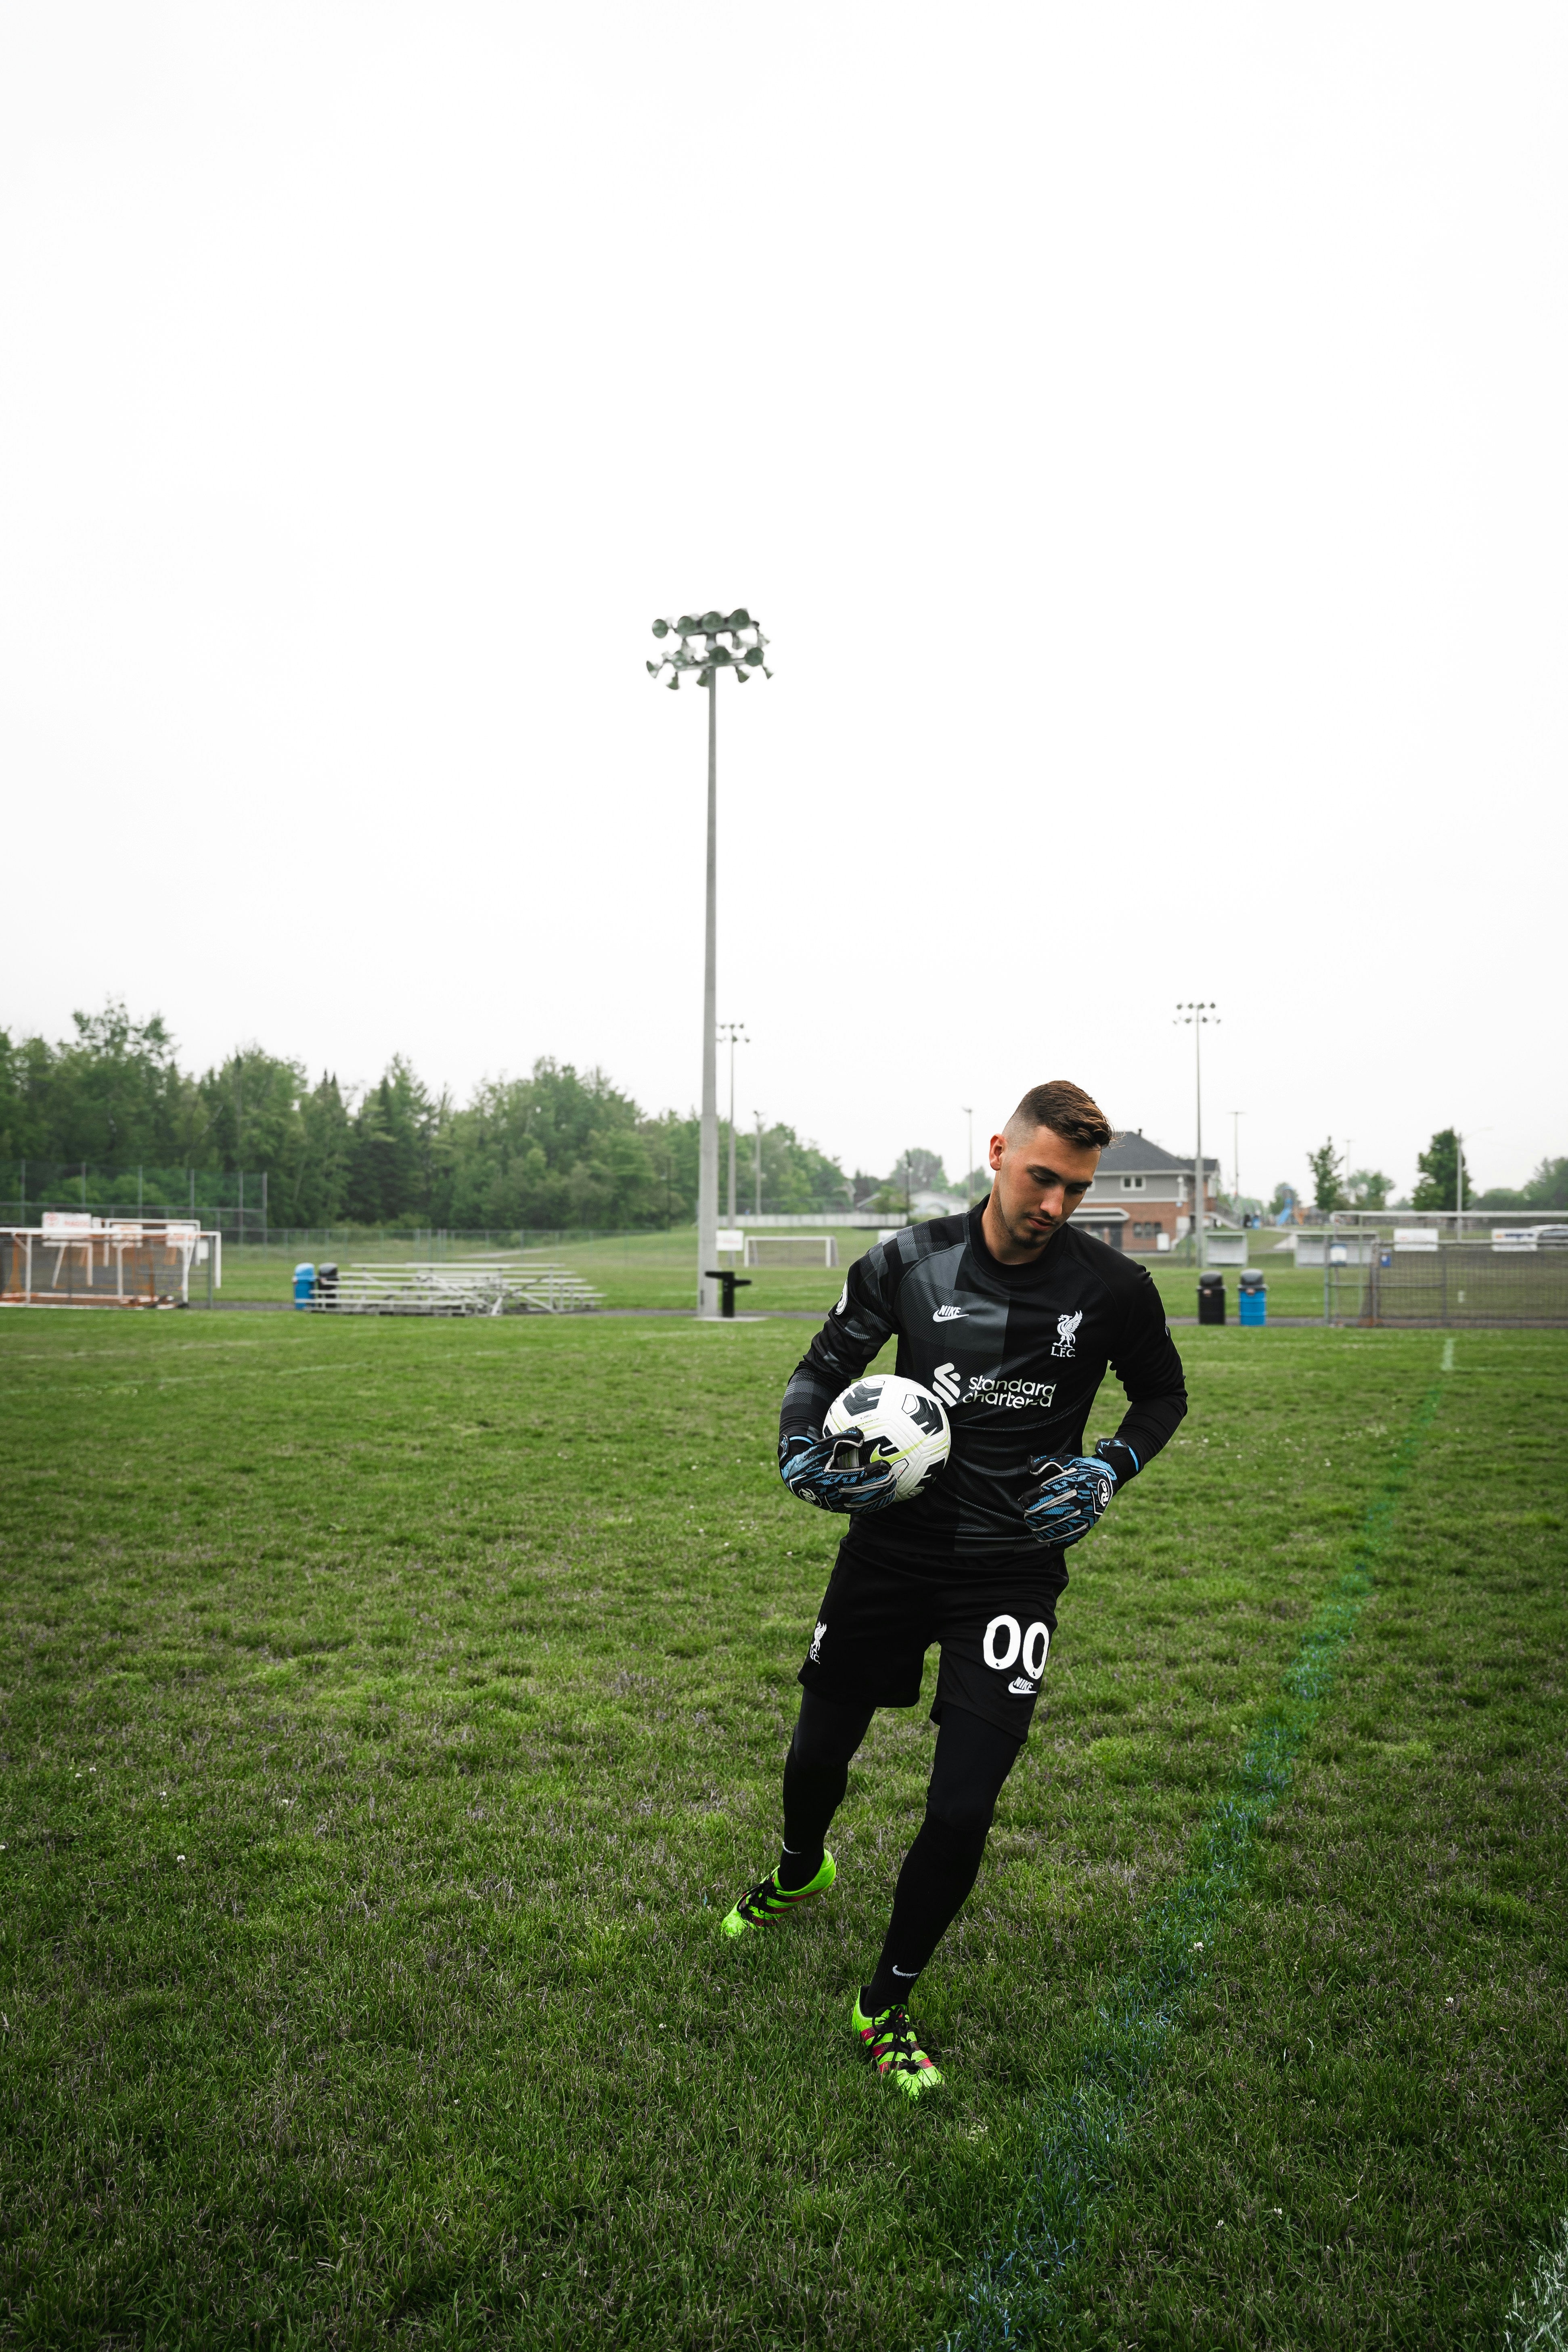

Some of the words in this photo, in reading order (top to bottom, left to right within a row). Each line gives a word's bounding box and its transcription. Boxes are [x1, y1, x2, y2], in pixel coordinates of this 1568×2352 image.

[938, 1305, 961, 1316] NIKE
[1051, 1346, 1076, 1357] L.F.C.
[969, 1375, 1057, 1396] standard
[983, 1615, 1049, 1680] 00
[1013, 1676, 1034, 1691] NIKE
